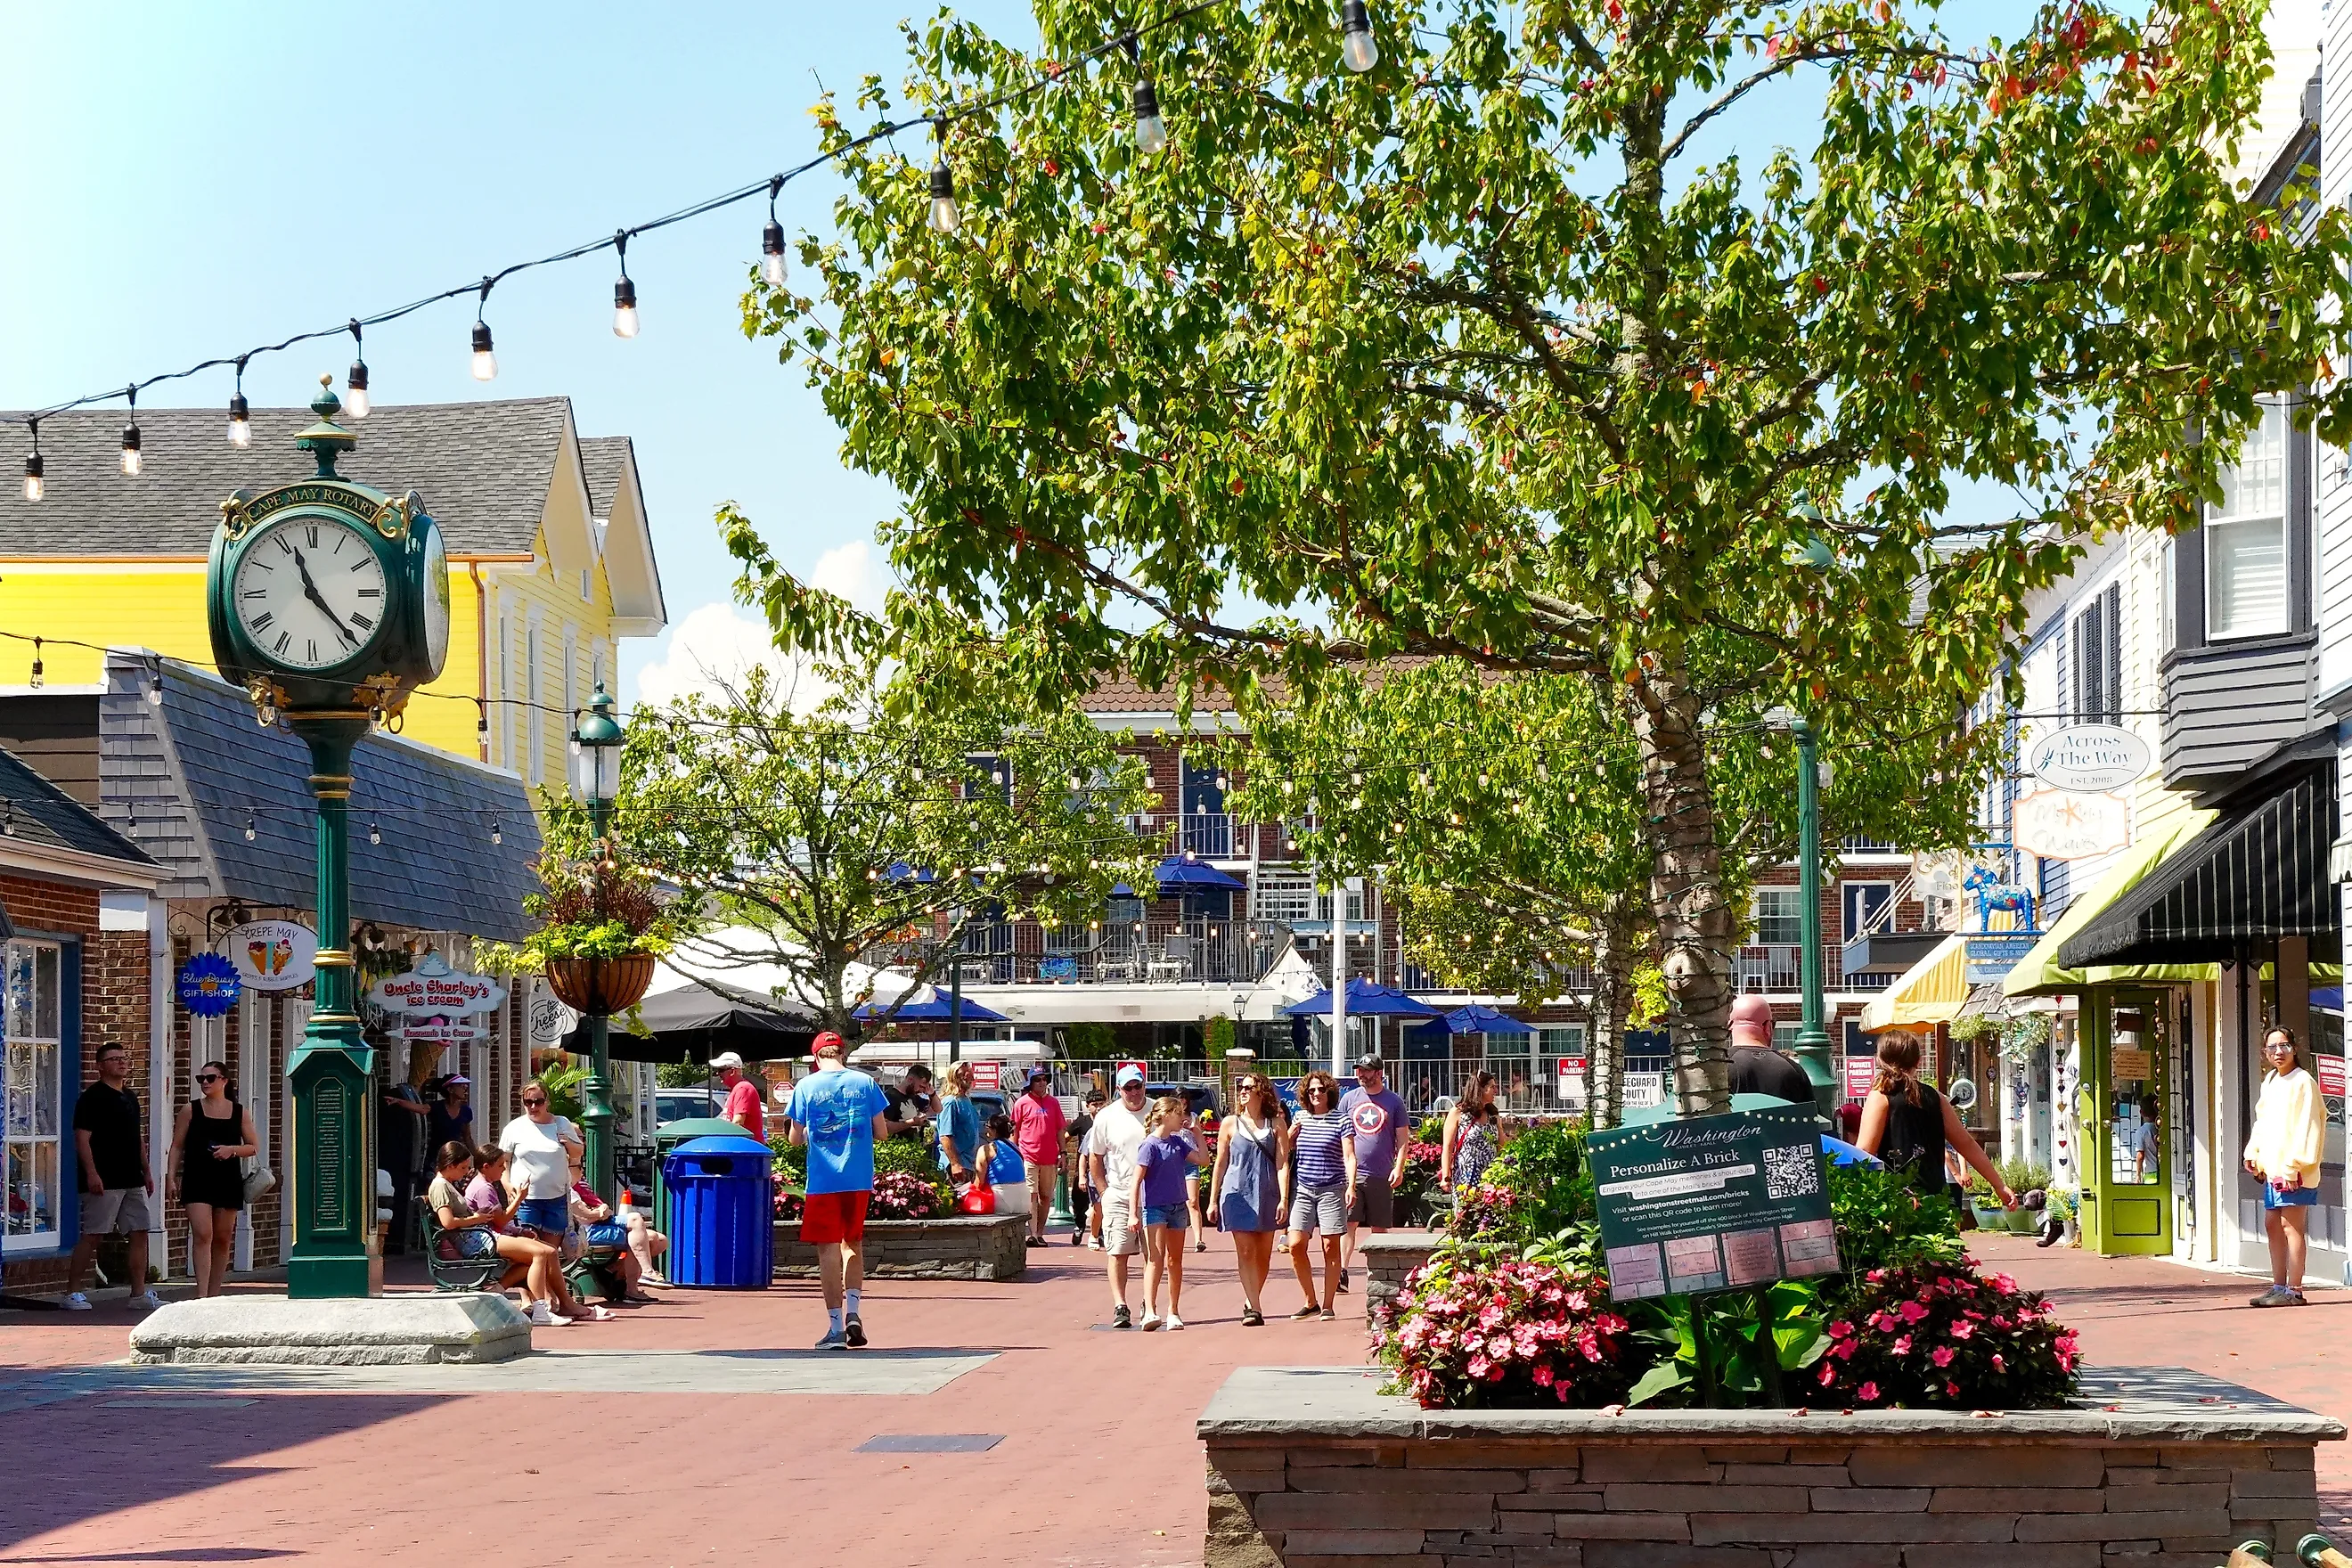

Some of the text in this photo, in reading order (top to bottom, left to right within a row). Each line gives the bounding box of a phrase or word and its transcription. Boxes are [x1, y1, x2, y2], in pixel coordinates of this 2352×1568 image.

[248, 488, 378, 519] CAPE MAY ROTARY
[306, 526, 318, 549] XII
[274, 534, 292, 558] XI
[358, 588, 380, 598] III
[2062, 735, 2121, 748] Across
[2056, 751, 2133, 767] The Way
[2091, 776, 2113, 784] 2008
[1936, 882, 1958, 891] Fine
[241, 926, 273, 939] CREPE
[183, 972, 235, 986] Blue Daisy
[184, 989, 234, 997] GIFT SHOP
[384, 979, 490, 999] Uncle Charley's
[406, 995, 464, 1006] ice cream
[542, 1021, 557, 1031] SHOP
[1627, 1089, 1646, 1098] DUTY
[1646, 1124, 1761, 1148] Washington
[1610, 1149, 1740, 1178] Personalize A Brick
[1602, 1184, 1629, 1195] Engrave
[1629, 1182, 1646, 1192] your
[1645, 1180, 1663, 1188] Cape
[1664, 1177, 1678, 1187] May
[1678, 1173, 1711, 1183] memories
[1718, 1167, 1753, 1178] shout-outs
[1682, 1182, 1701, 1191] Mall's
[1612, 1189, 1750, 1214] Visit washingtonstreetmall.com/bricks
[1648, 1211, 1662, 1220] this
[1662, 1210, 1674, 1219] QR
[1675, 1207, 1693, 1215] code
[1702, 1203, 1720, 1212] learn
[1721, 1201, 1743, 1209] more!
[1646, 1223, 1671, 1232] examples
[1678, 1219, 1700, 1229] yourself
[1748, 1209, 1780, 1217] Washington
[1672, 1226, 1695, 1235] between
